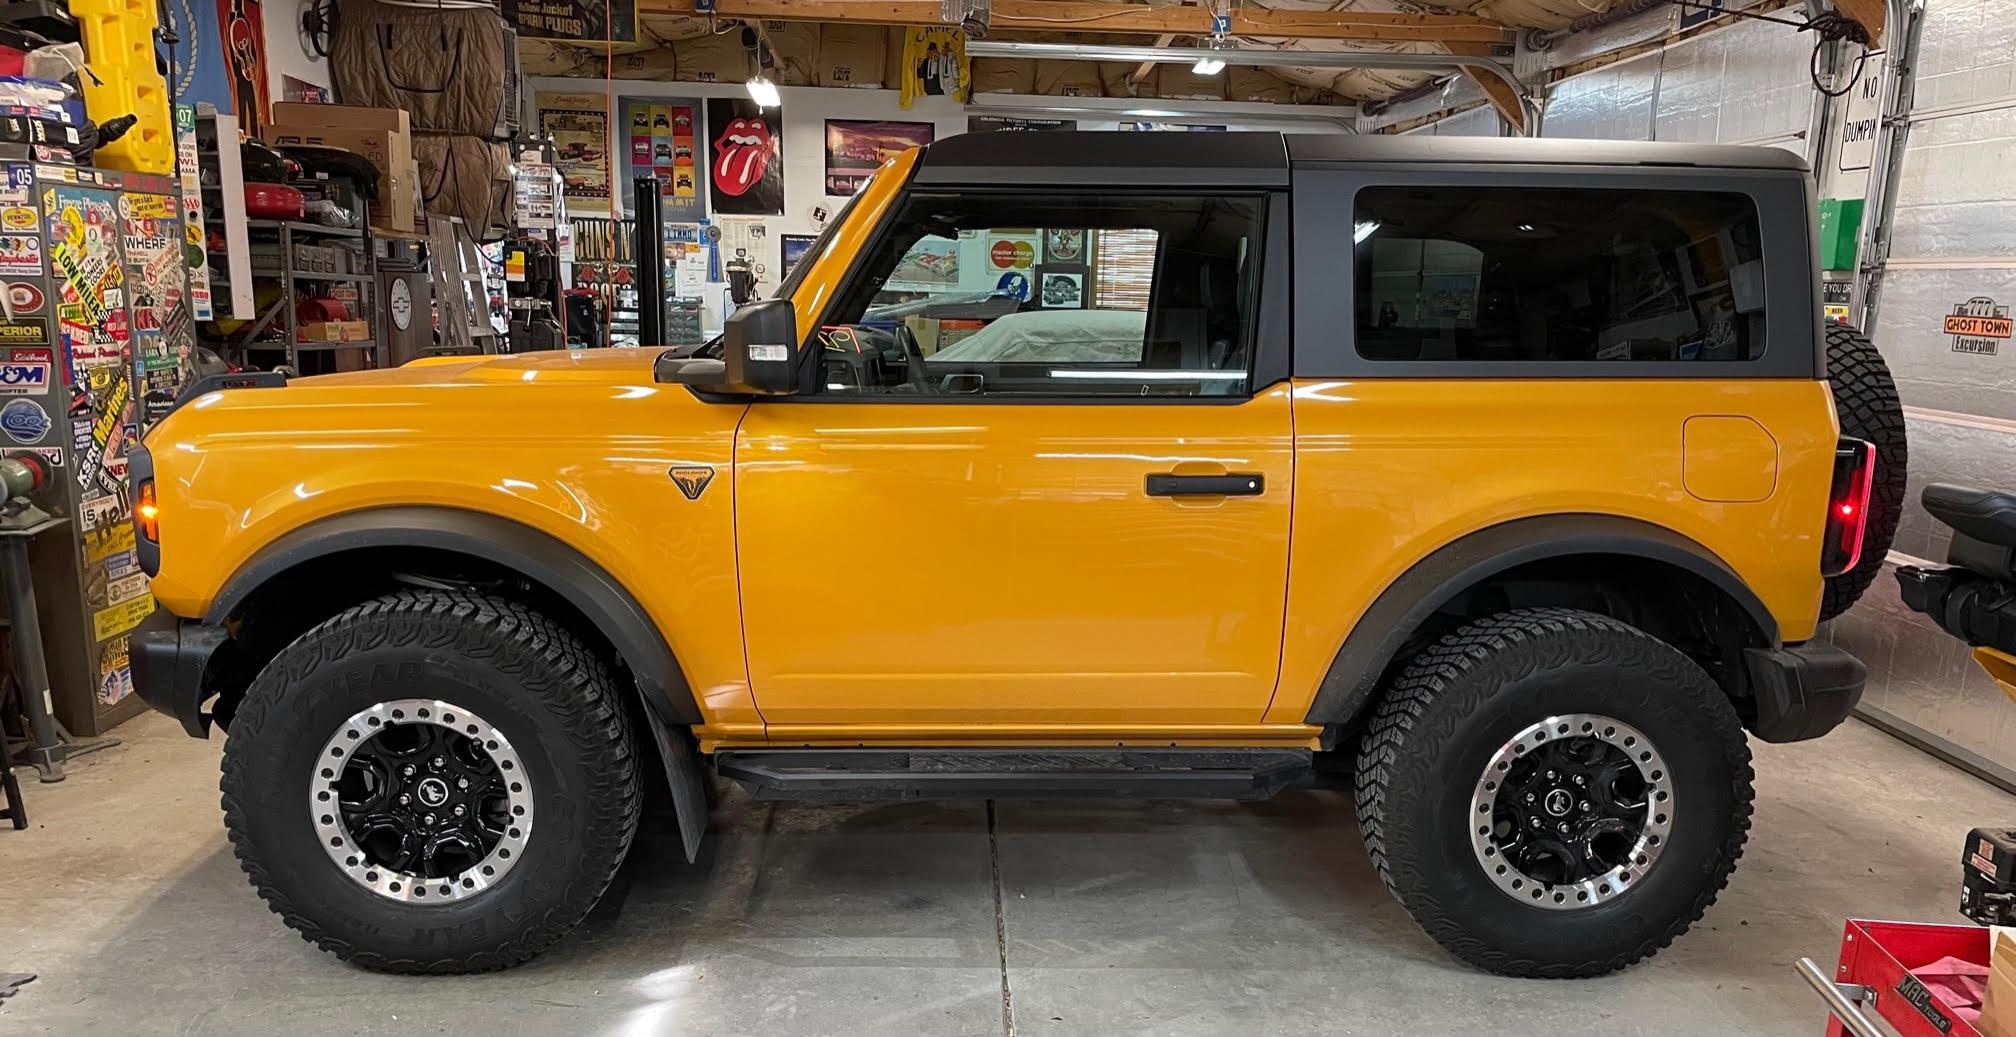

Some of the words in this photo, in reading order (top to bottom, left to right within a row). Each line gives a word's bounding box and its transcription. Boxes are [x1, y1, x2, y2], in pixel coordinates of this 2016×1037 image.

[541, 3, 574, 16] Jacket
[518, 13, 544, 28] SPARK
[545, 17, 582, 36] PLUGS
[1863, 76, 1877, 99] NO
[179, 109, 192, 122] 07
[17, 169, 32, 185] 05
[125, 236, 166, 250] WHERE
[574, 221, 615, 261] GUNS
[0, 252, 38, 265] aybestos
[58, 249, 79, 280] LOW
[1971, 300, 1992, 316] 777
[1947, 319, 1978, 331] GHOST
[1980, 320, 2010, 334] TOWN
[1956, 336, 1996, 353] Excursion
[93, 379, 128, 447] Marines
[81, 497, 114, 511] EVERYBODY
[1898, 976, 1929, 1007] MAC
